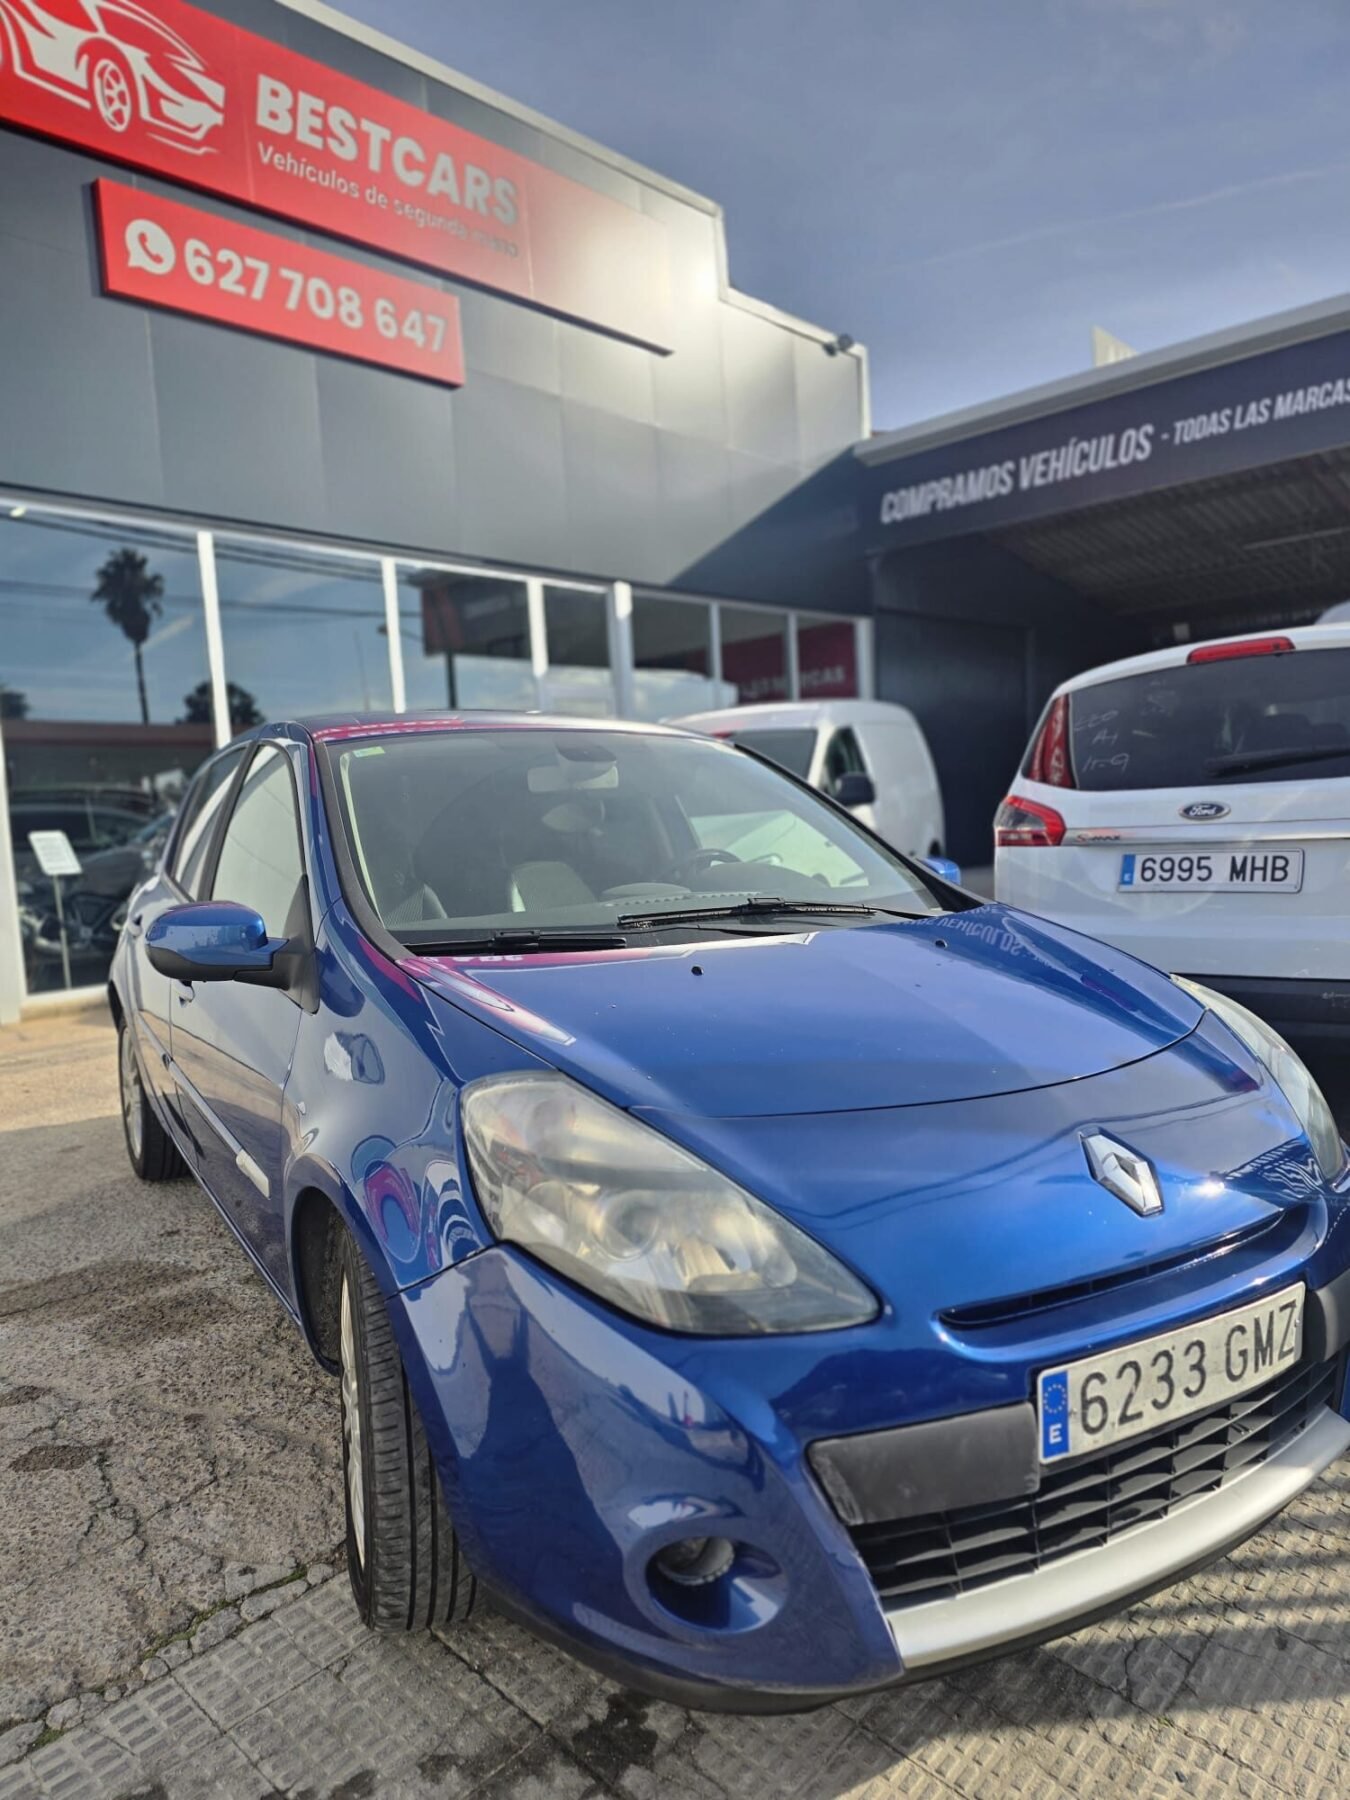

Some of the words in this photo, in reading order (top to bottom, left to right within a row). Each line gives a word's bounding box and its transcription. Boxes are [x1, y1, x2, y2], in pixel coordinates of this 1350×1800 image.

[256, 73, 518, 226] BESTCARS
[258, 142, 361, 199] Vehículos
[365, 185, 389, 210] de
[184, 238, 271, 300] 627
[280, 268, 364, 330] 708
[374, 298, 447, 353] 647
[880, 460, 1014, 524] COMPRAMOS
[1017, 423, 1155, 491] VEHÍCULOS
[1172, 408, 1232, 445] TODAS
[1233, 397, 1272, 431] LAS
[1189, 805, 1217, 817] Ford
[1140, 856, 1213, 883] 6995
[1229, 855, 1290, 883] MHB
[1080, 1339, 1207, 1436] 6233
[1224, 1299, 1298, 1383] GMZ
[1049, 1423, 1063, 1444] E
